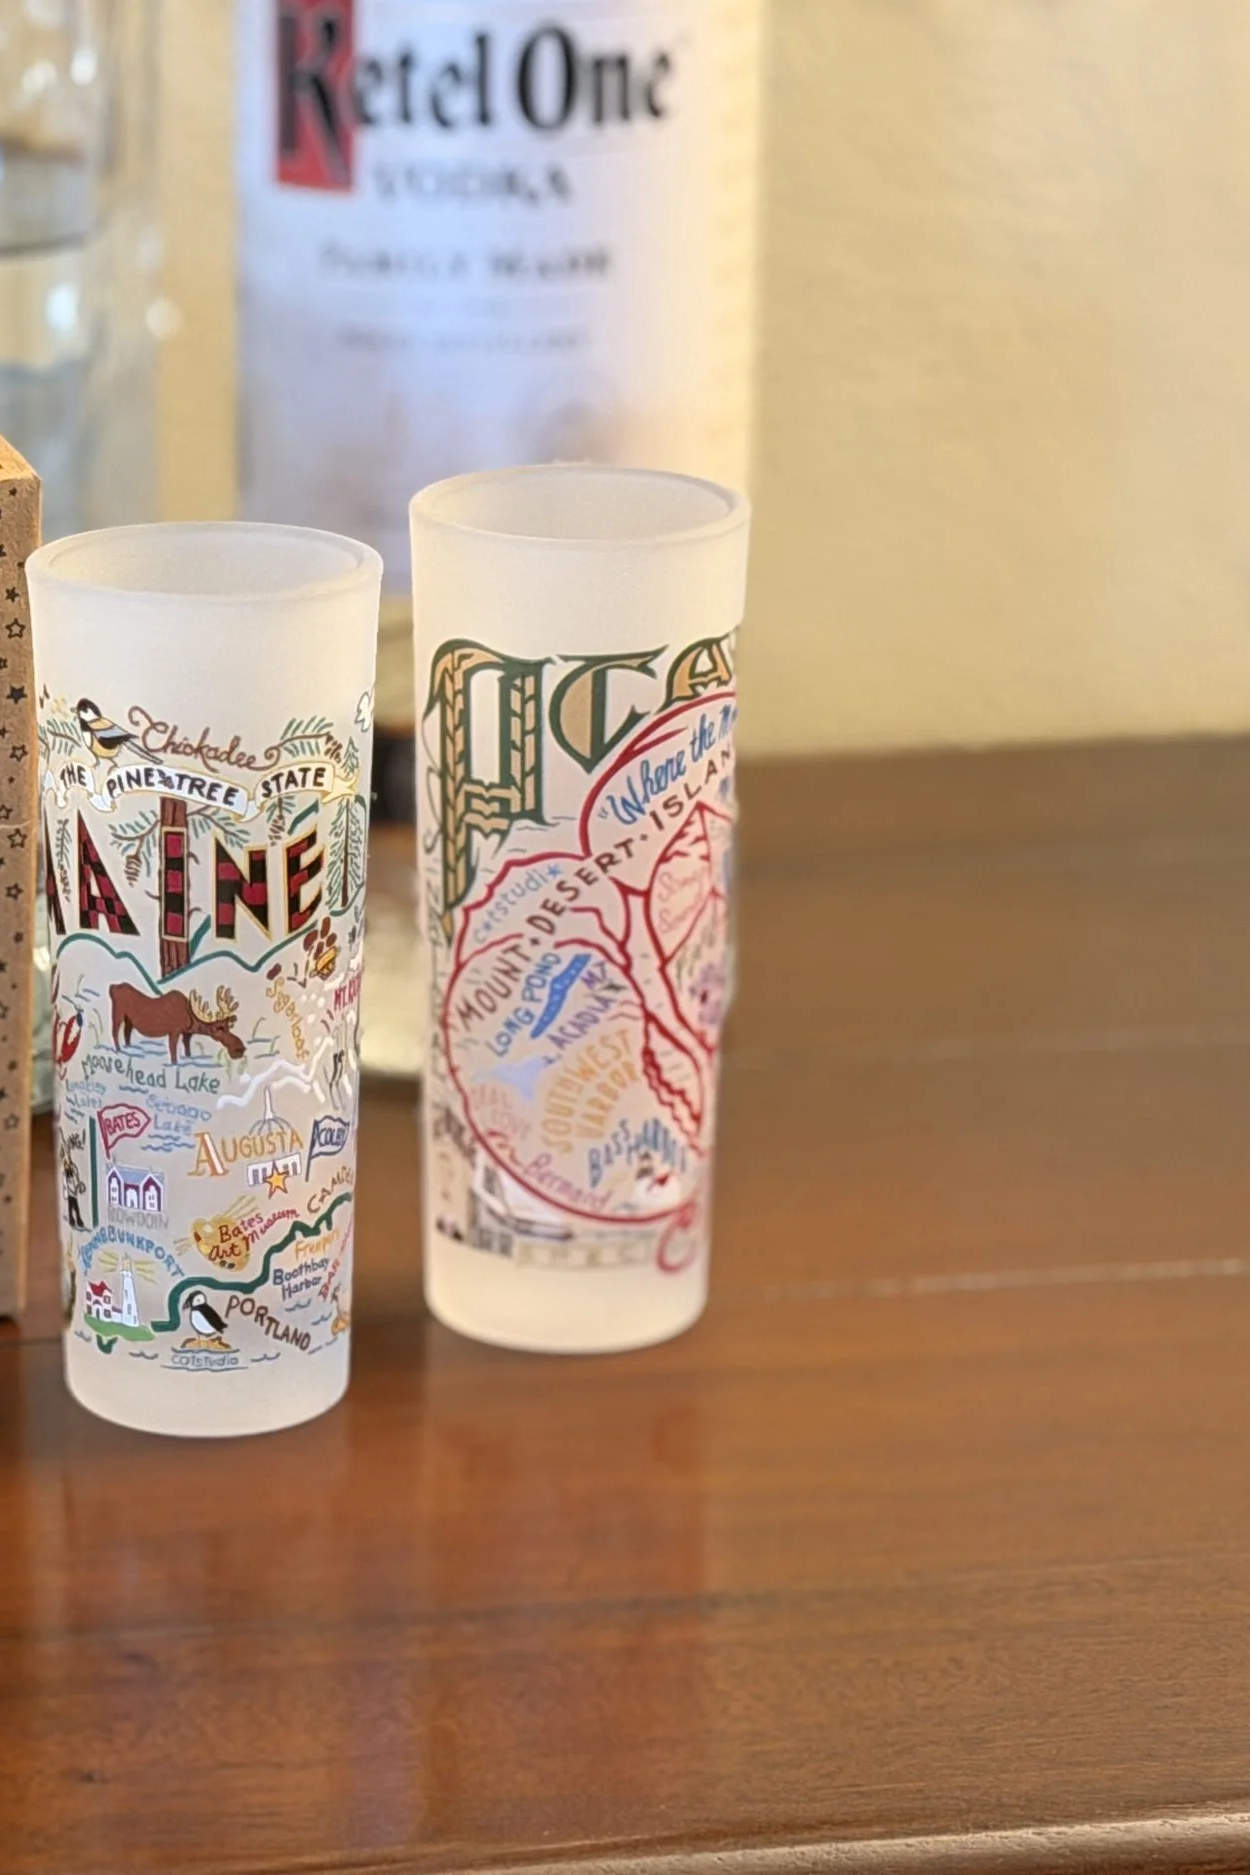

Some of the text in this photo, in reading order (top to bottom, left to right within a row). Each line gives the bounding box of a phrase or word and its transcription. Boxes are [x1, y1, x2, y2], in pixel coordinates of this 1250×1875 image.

[278, 8, 674, 183] Ketel One
[690, 713, 716, 763] the
[59, 765, 326, 807] THE PINE TREE STATE
[456, 943, 532, 1032] MOUNT
[526, 838, 636, 936] DESERT
[484, 952, 562, 1058] LONG POND
[81, 1055, 167, 1089] Moosehead
[175, 1066, 221, 1094] Lake
[105, 1112, 141, 1135] BATES
[188, 1128, 304, 1176] AUGUSTA
[219, 1213, 264, 1244] Bates
[208, 1243, 241, 1262] Art
[273, 1257, 330, 1286] Boothbay
[281, 1274, 322, 1301] Harbor
[225, 1295, 311, 1351] PORTLAND
